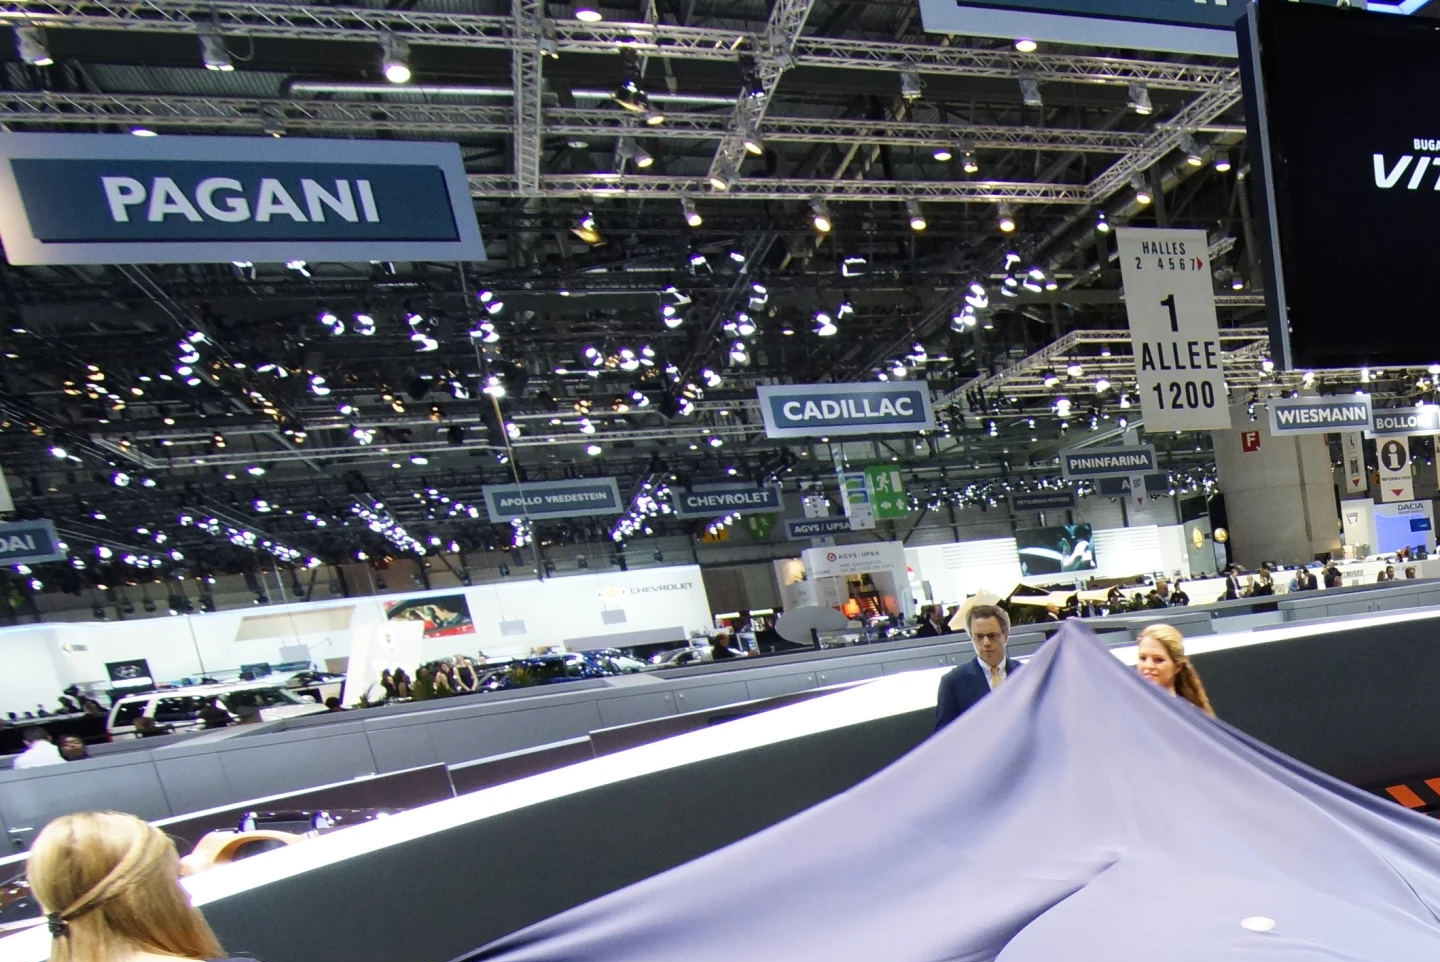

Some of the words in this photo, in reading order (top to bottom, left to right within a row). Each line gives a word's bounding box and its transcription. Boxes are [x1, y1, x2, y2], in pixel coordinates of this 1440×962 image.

[101, 176, 380, 222] PAGANI
[1142, 241, 1186, 255] HALLES
[1135, 257, 1142, 270] 2
[1160, 294, 1179, 332] 1
[1142, 341, 1218, 370] ALLEE
[1153, 381, 1215, 409] 1200
[783, 397, 914, 421] CADILLAC
[1277, 406, 1366, 424] WIESMANN
[1070, 455, 1149, 470] PININFARINA
[500, 496, 543, 507] APOLLO
[545, 492, 607, 504] VREDESTEIN
[687, 491, 770, 507] CHEVROLET
[1397, 502, 1424, 511] DACIA
[795, 524, 820, 532] AGVS
[826, 522, 850, 530] UPSA
[630, 582, 693, 594] CHEVROLET
